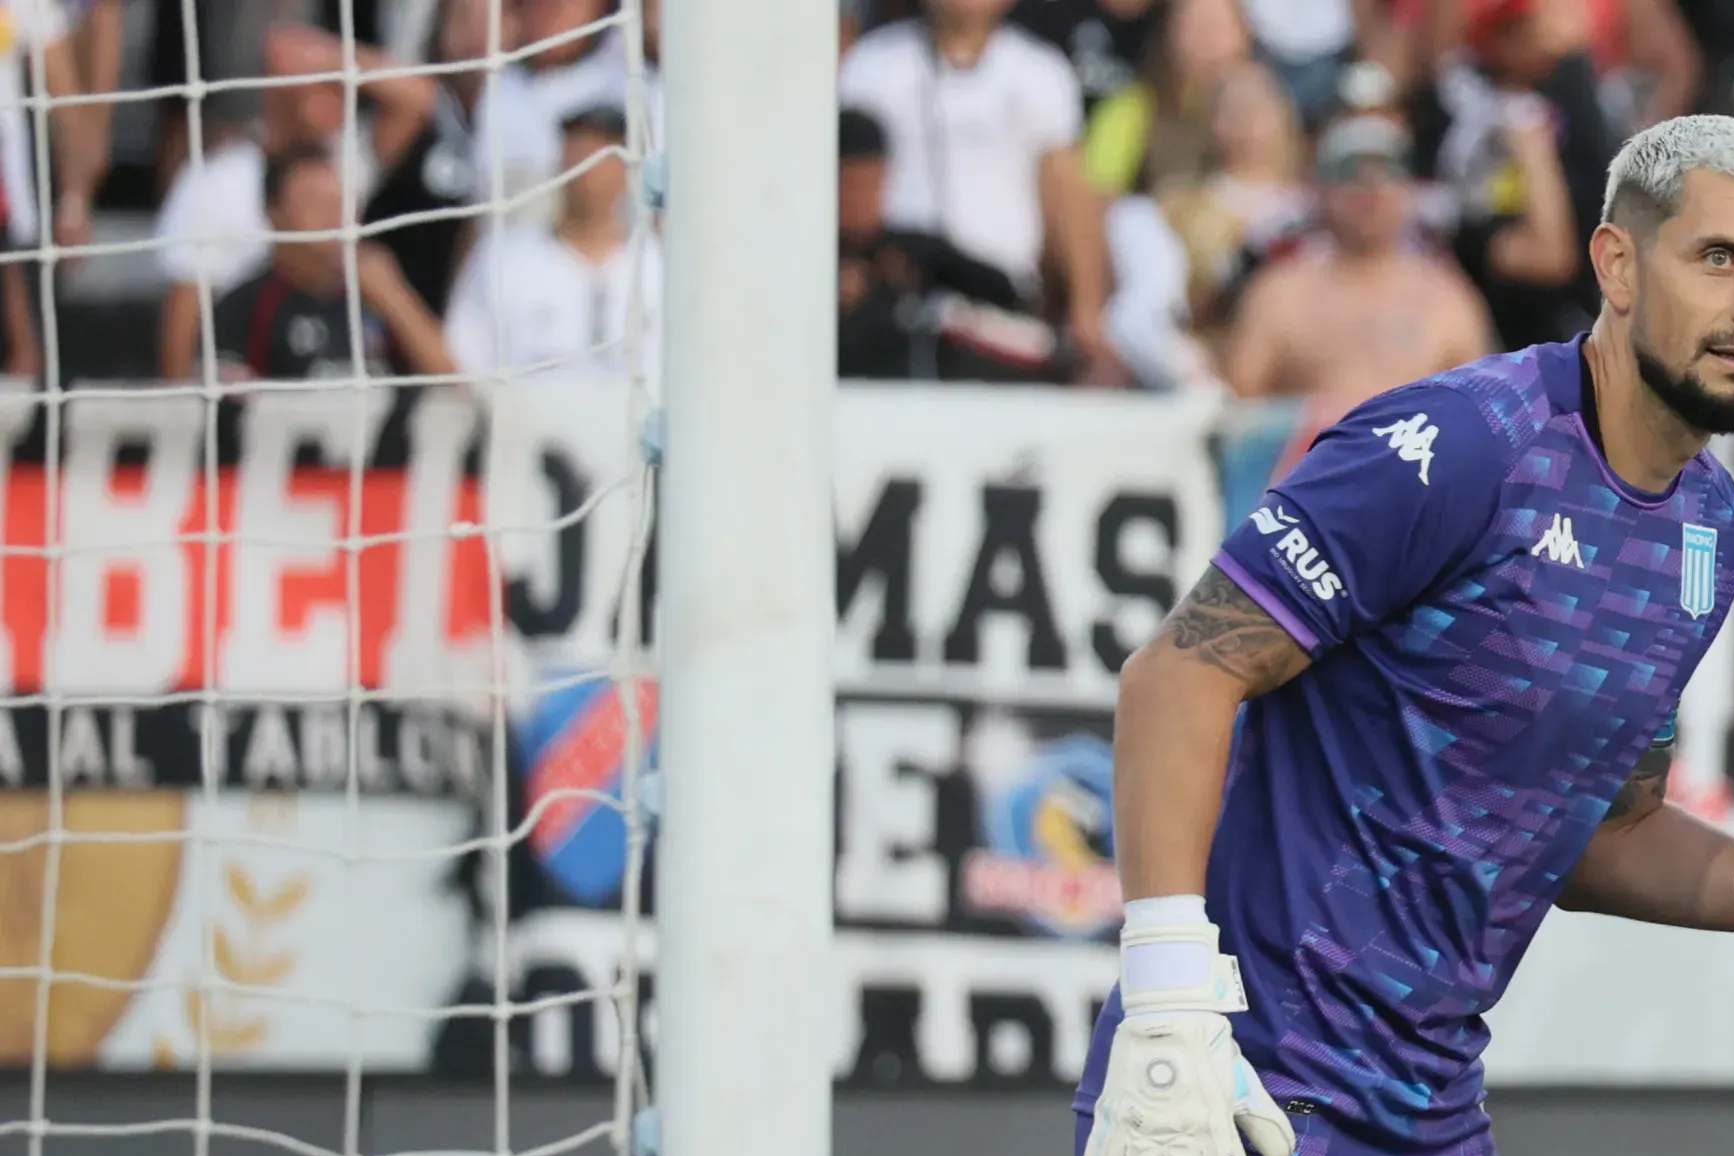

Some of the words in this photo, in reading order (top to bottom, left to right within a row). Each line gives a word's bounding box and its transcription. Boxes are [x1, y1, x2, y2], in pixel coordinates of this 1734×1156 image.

[0, 382, 505, 702] BEL
[508, 438, 1182, 676] JMÁS
[1276, 528, 1342, 600] RUS
